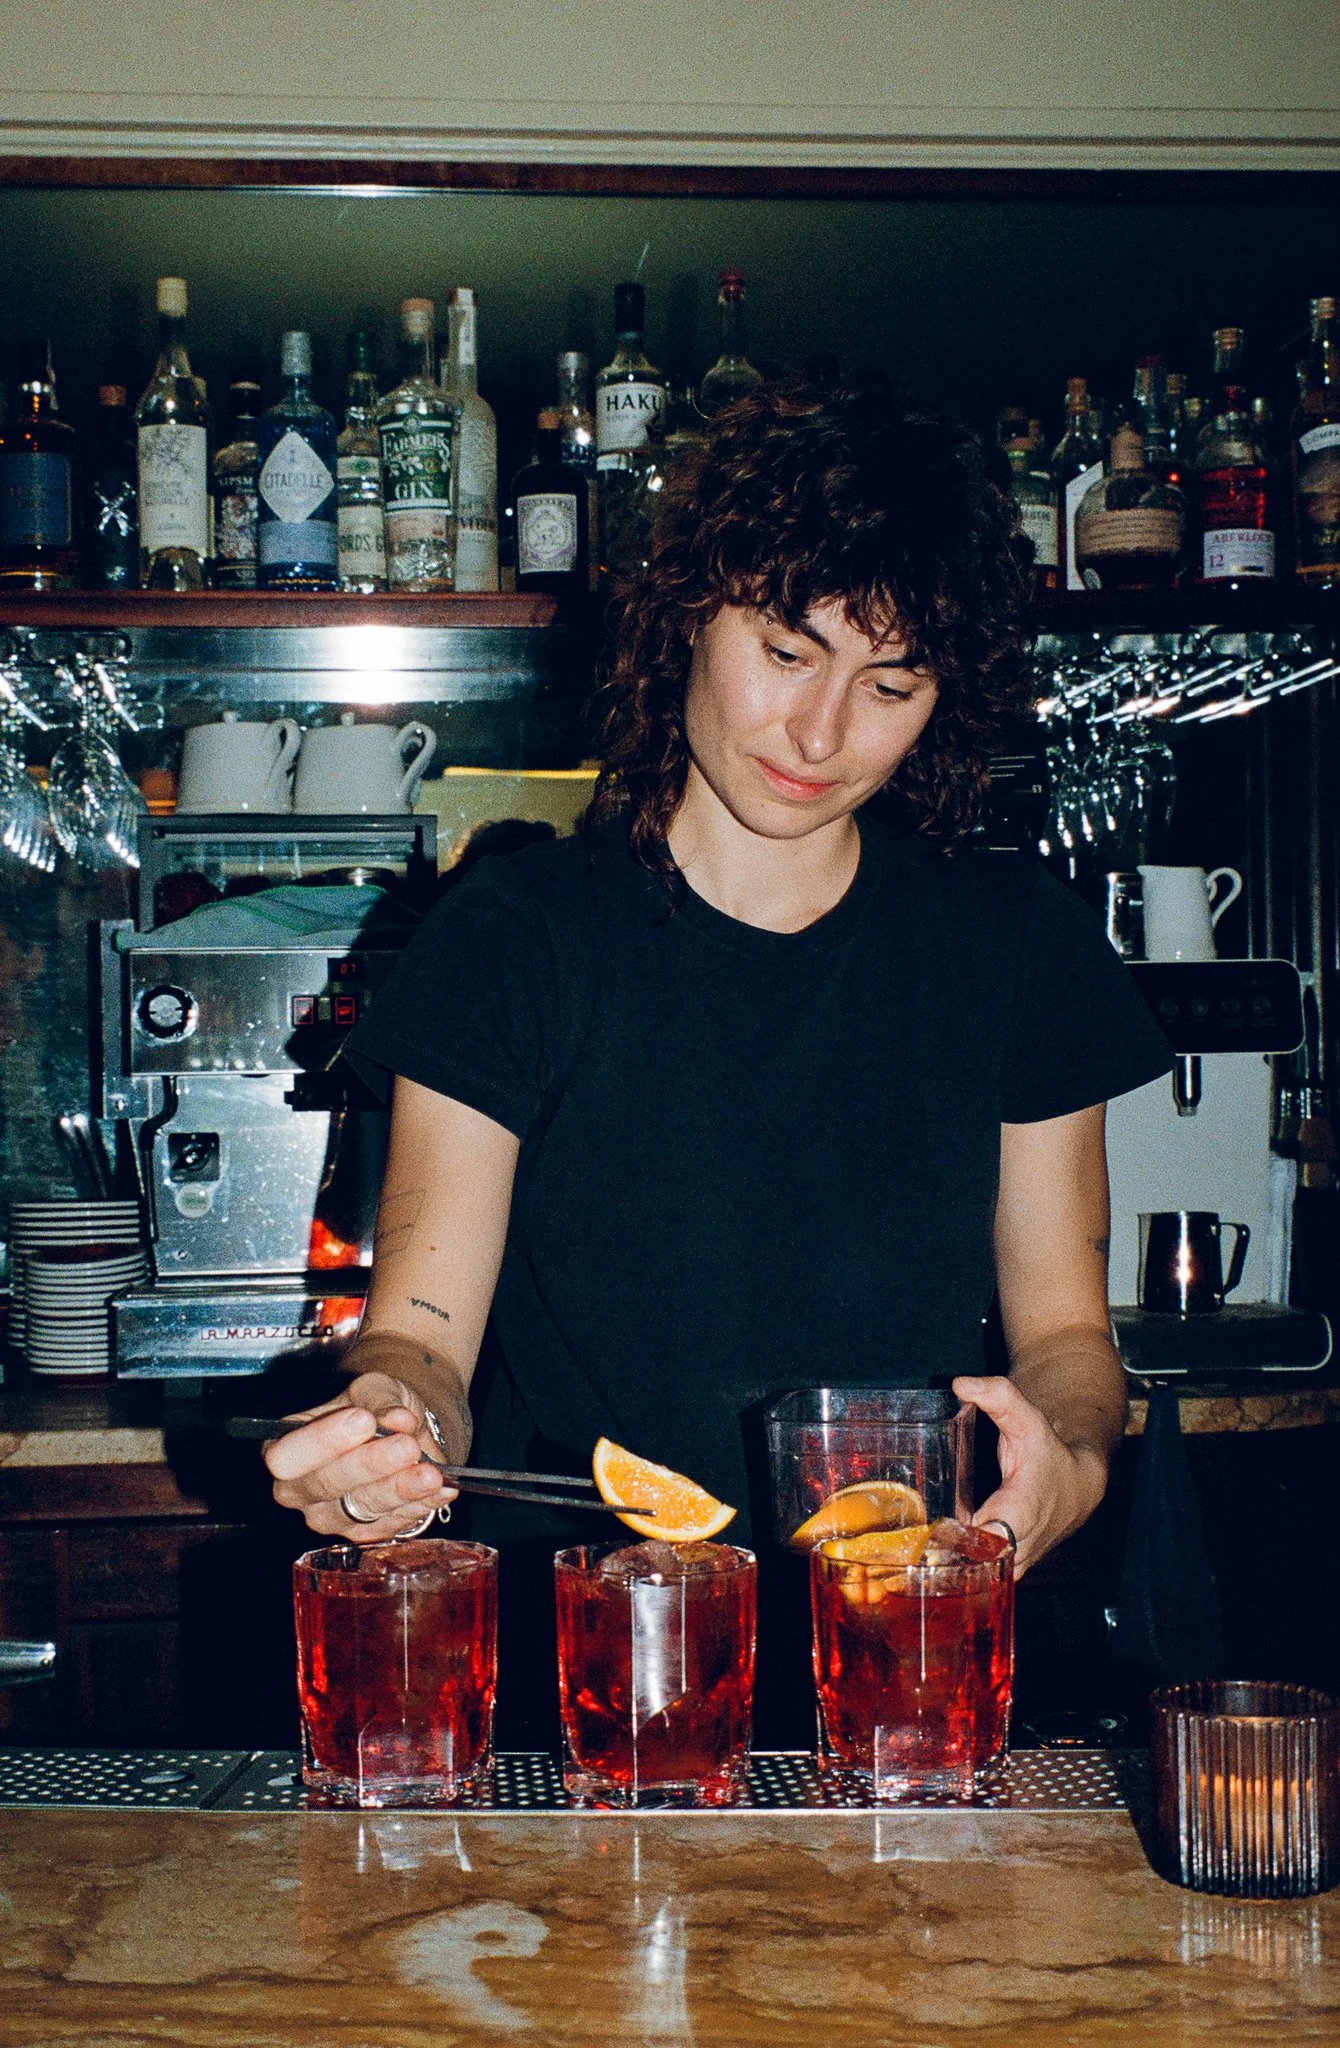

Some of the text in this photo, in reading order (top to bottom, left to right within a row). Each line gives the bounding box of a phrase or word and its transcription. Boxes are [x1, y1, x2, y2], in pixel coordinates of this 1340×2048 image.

[606, 394, 661, 412] HAKU
[1304, 428, 1340, 446] COMPA
[394, 482, 433, 499] GIN
[339, 534, 372, 552] ORDS
